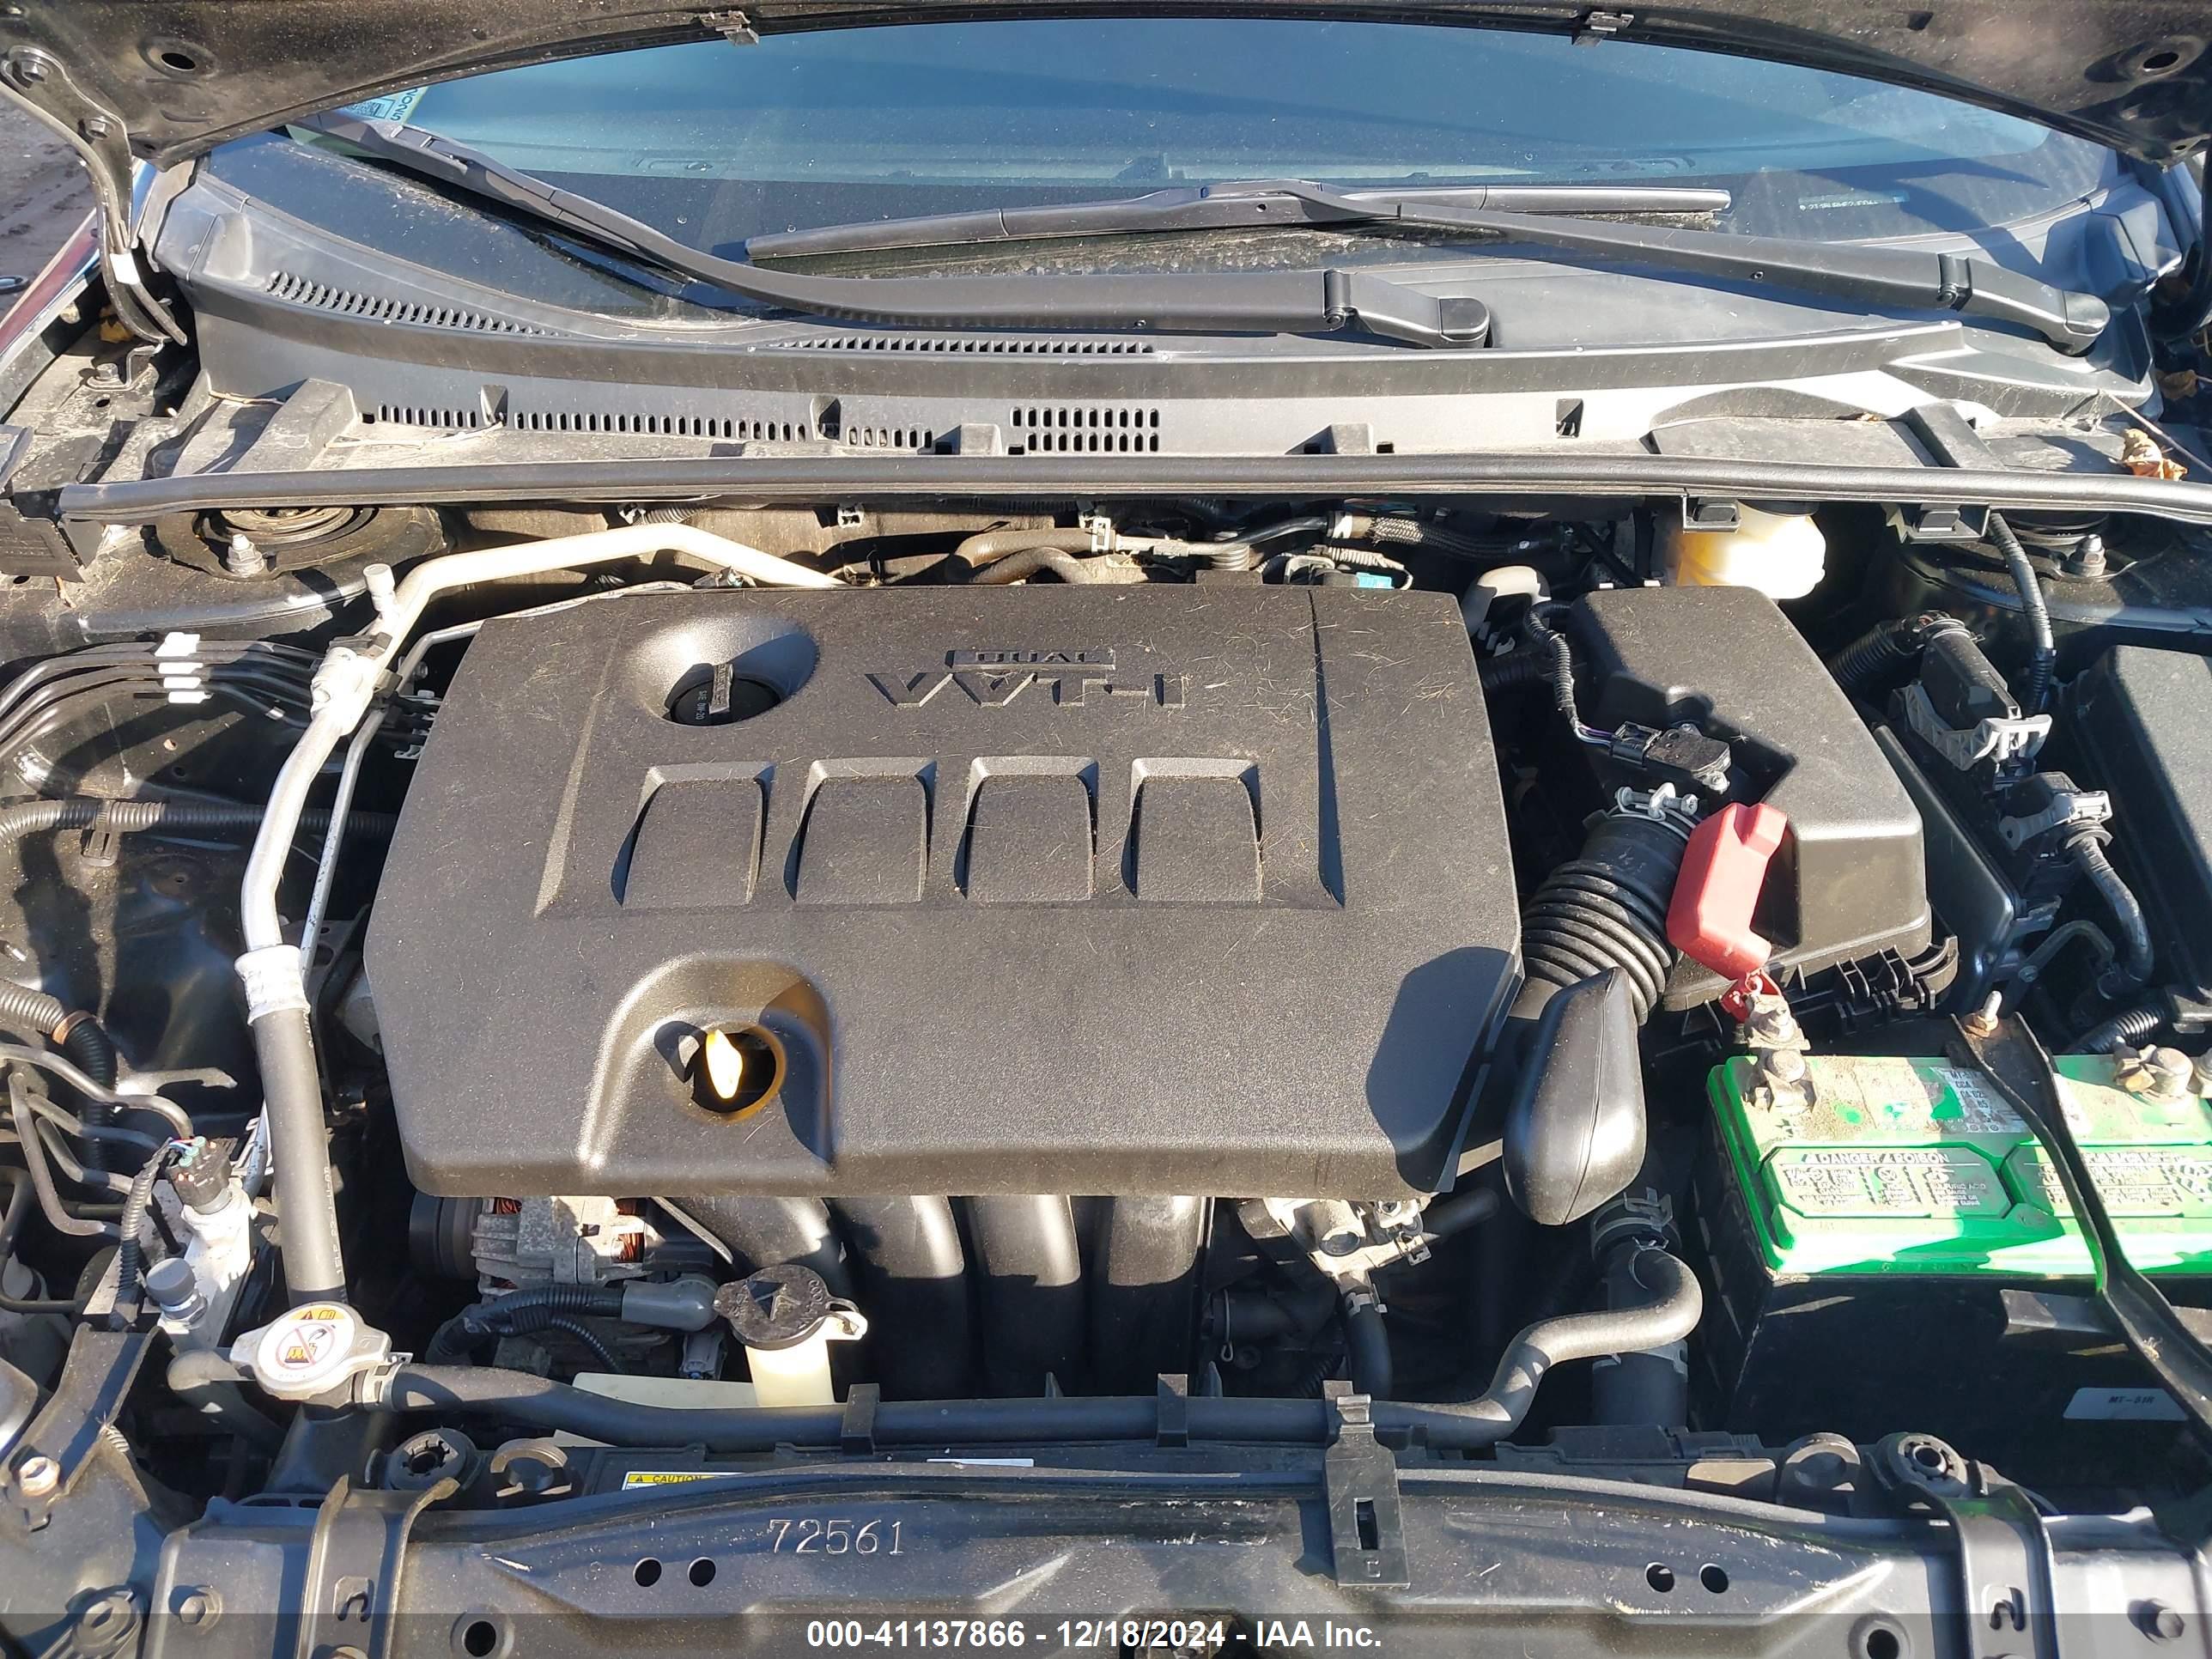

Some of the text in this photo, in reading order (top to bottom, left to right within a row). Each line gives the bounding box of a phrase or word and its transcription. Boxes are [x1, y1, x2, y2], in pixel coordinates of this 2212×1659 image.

[391, 88, 418, 121] 2025
[975, 651, 1101, 664] DUAL
[770, 1519, 903, 1555] 72561
